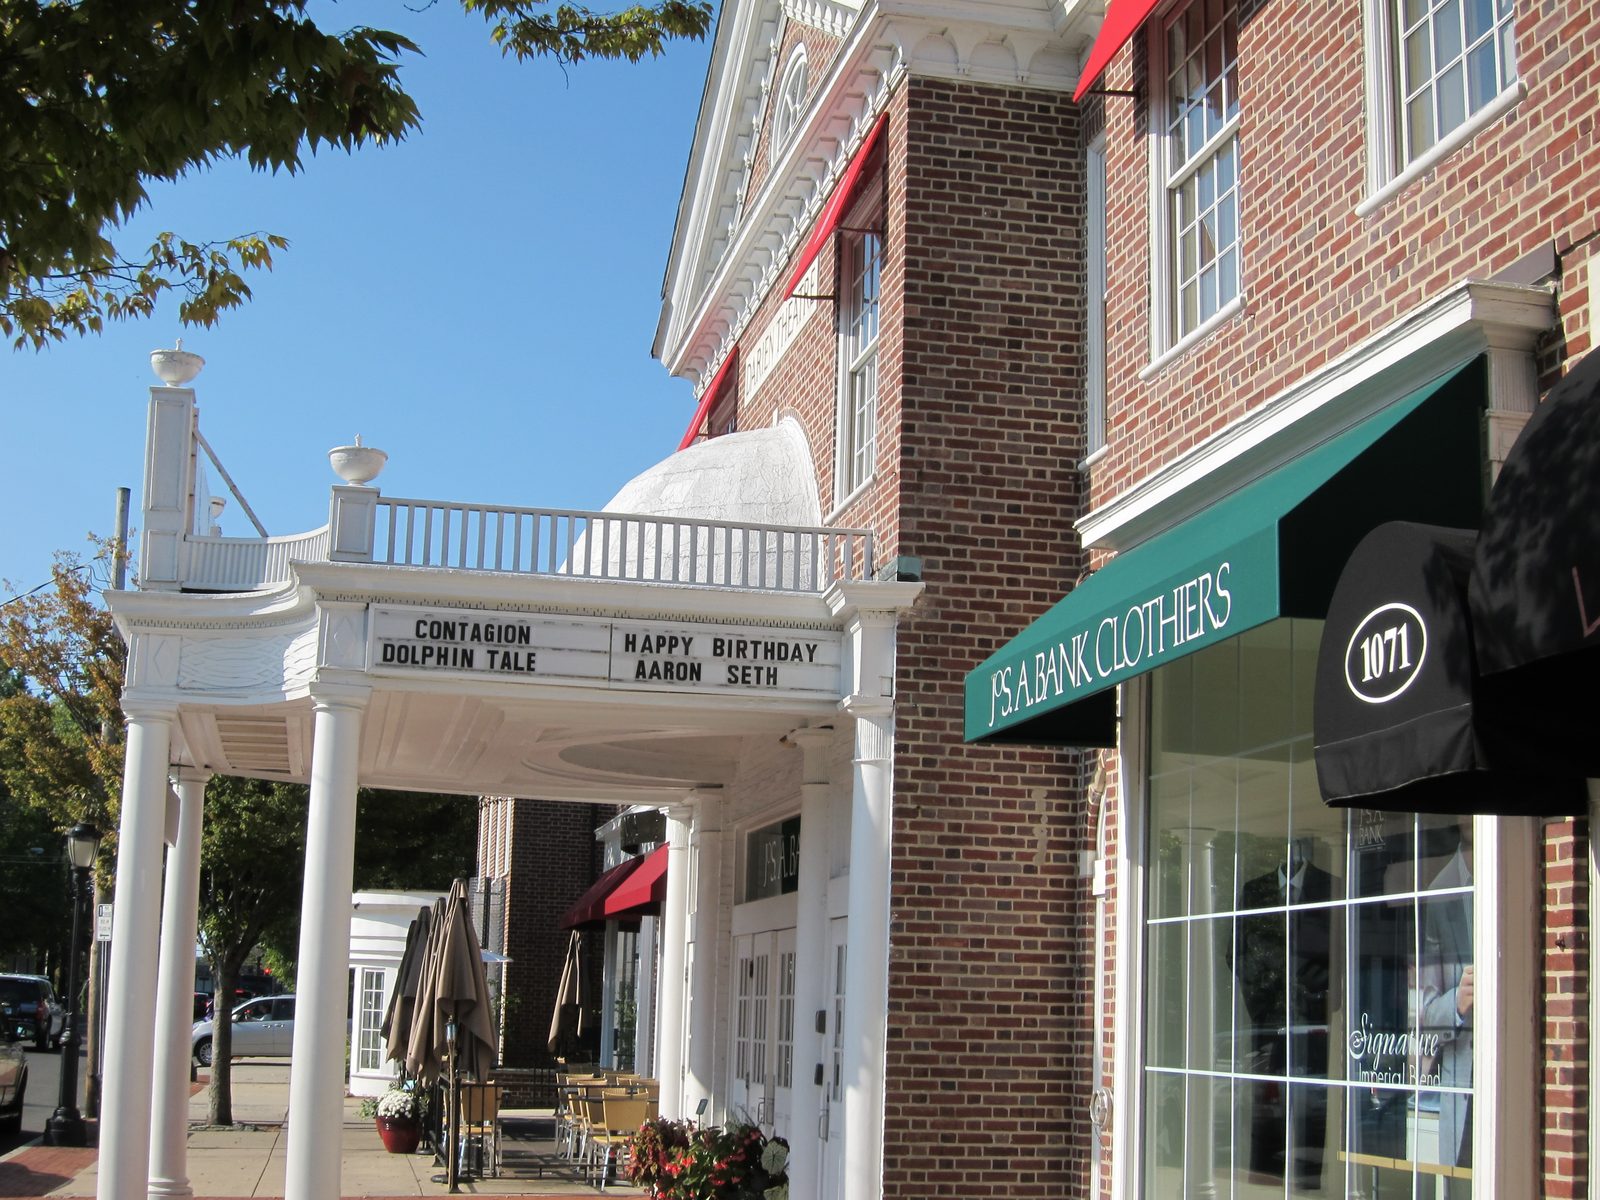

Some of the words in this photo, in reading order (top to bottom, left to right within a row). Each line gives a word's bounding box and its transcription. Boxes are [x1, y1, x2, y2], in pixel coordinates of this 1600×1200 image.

[415, 619, 531, 645] CONTAGION
[1014, 659, 1034, 712] A.
[1034, 630, 1093, 704] BANK
[1095, 562, 1232, 678] CLOTHIERS
[382, 643, 474, 668] DOLPHIN
[487, 650, 536, 672] TALE
[624, 633, 694, 656] HAPPY
[712, 637, 818, 664] BIRTHDAY
[1360, 622, 1411, 683] 1071
[635, 660, 702, 682] AARON
[727, 664, 779, 686] SETH
[1350, 1012, 1439, 1070] Signature
